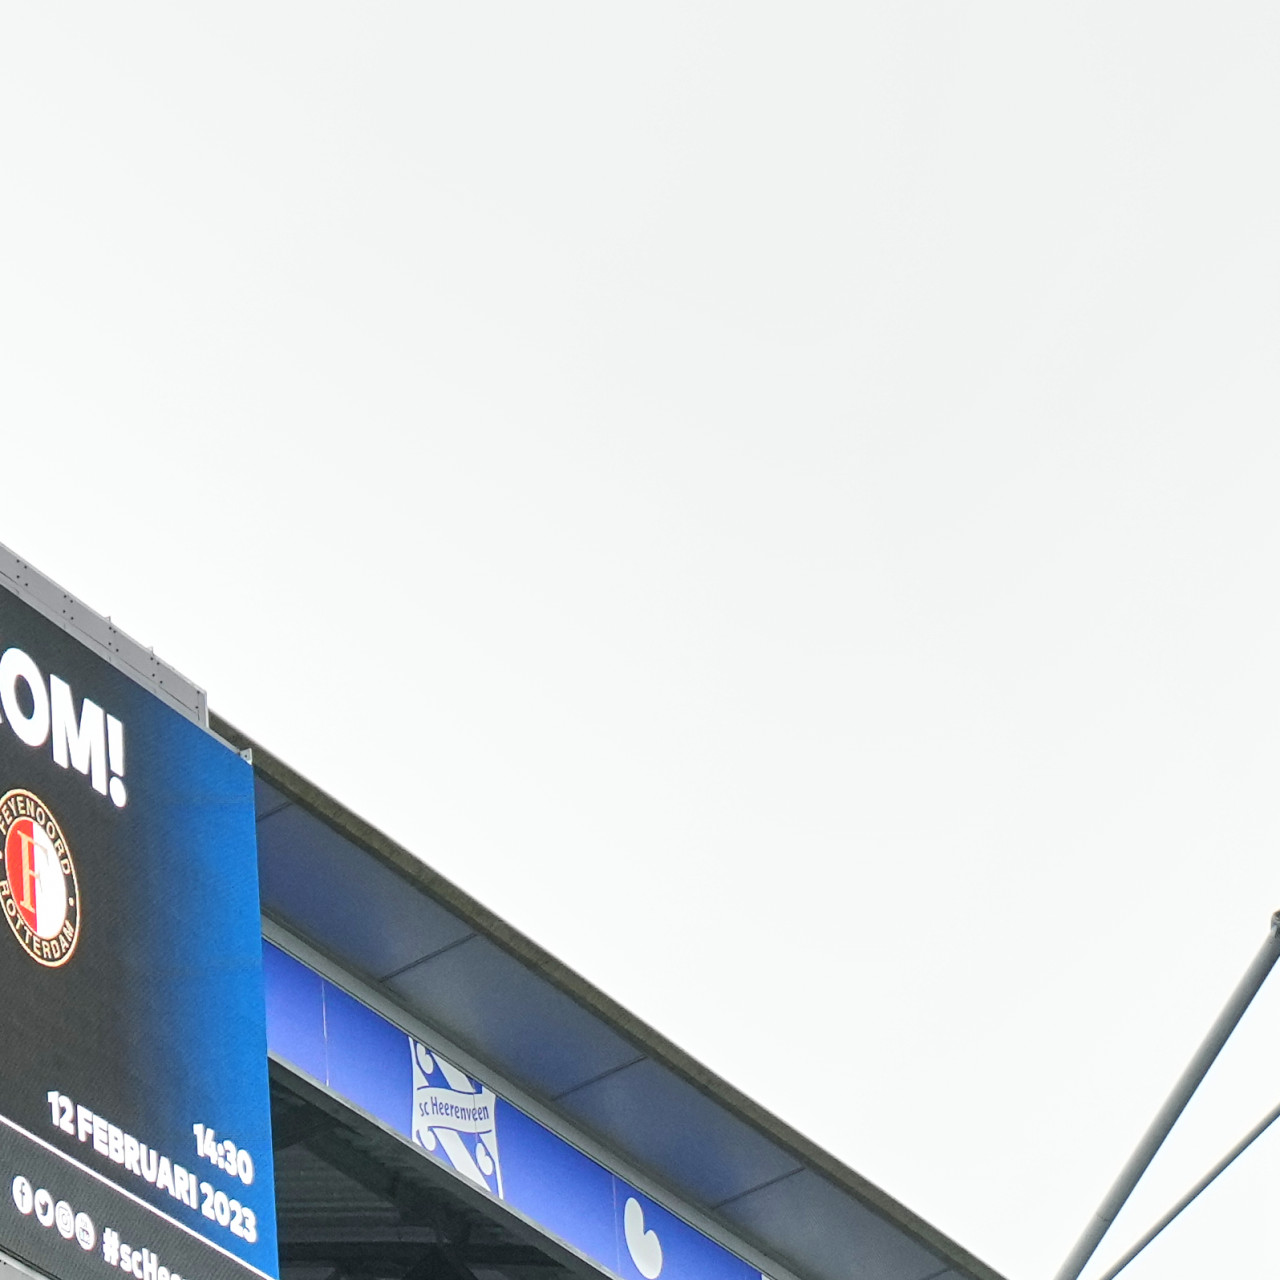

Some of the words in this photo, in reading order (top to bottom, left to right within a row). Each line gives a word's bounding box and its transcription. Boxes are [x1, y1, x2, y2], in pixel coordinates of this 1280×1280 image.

[419, 1100, 430, 1117] sc
[430, 1096, 490, 1121] Heerenveen
[47, 1090, 77, 1136] 12
[76, 1103, 198, 1210] FEBRUARI
[199, 1181, 258, 1244] 2023
[192, 1123, 255, 1185] 14:30
